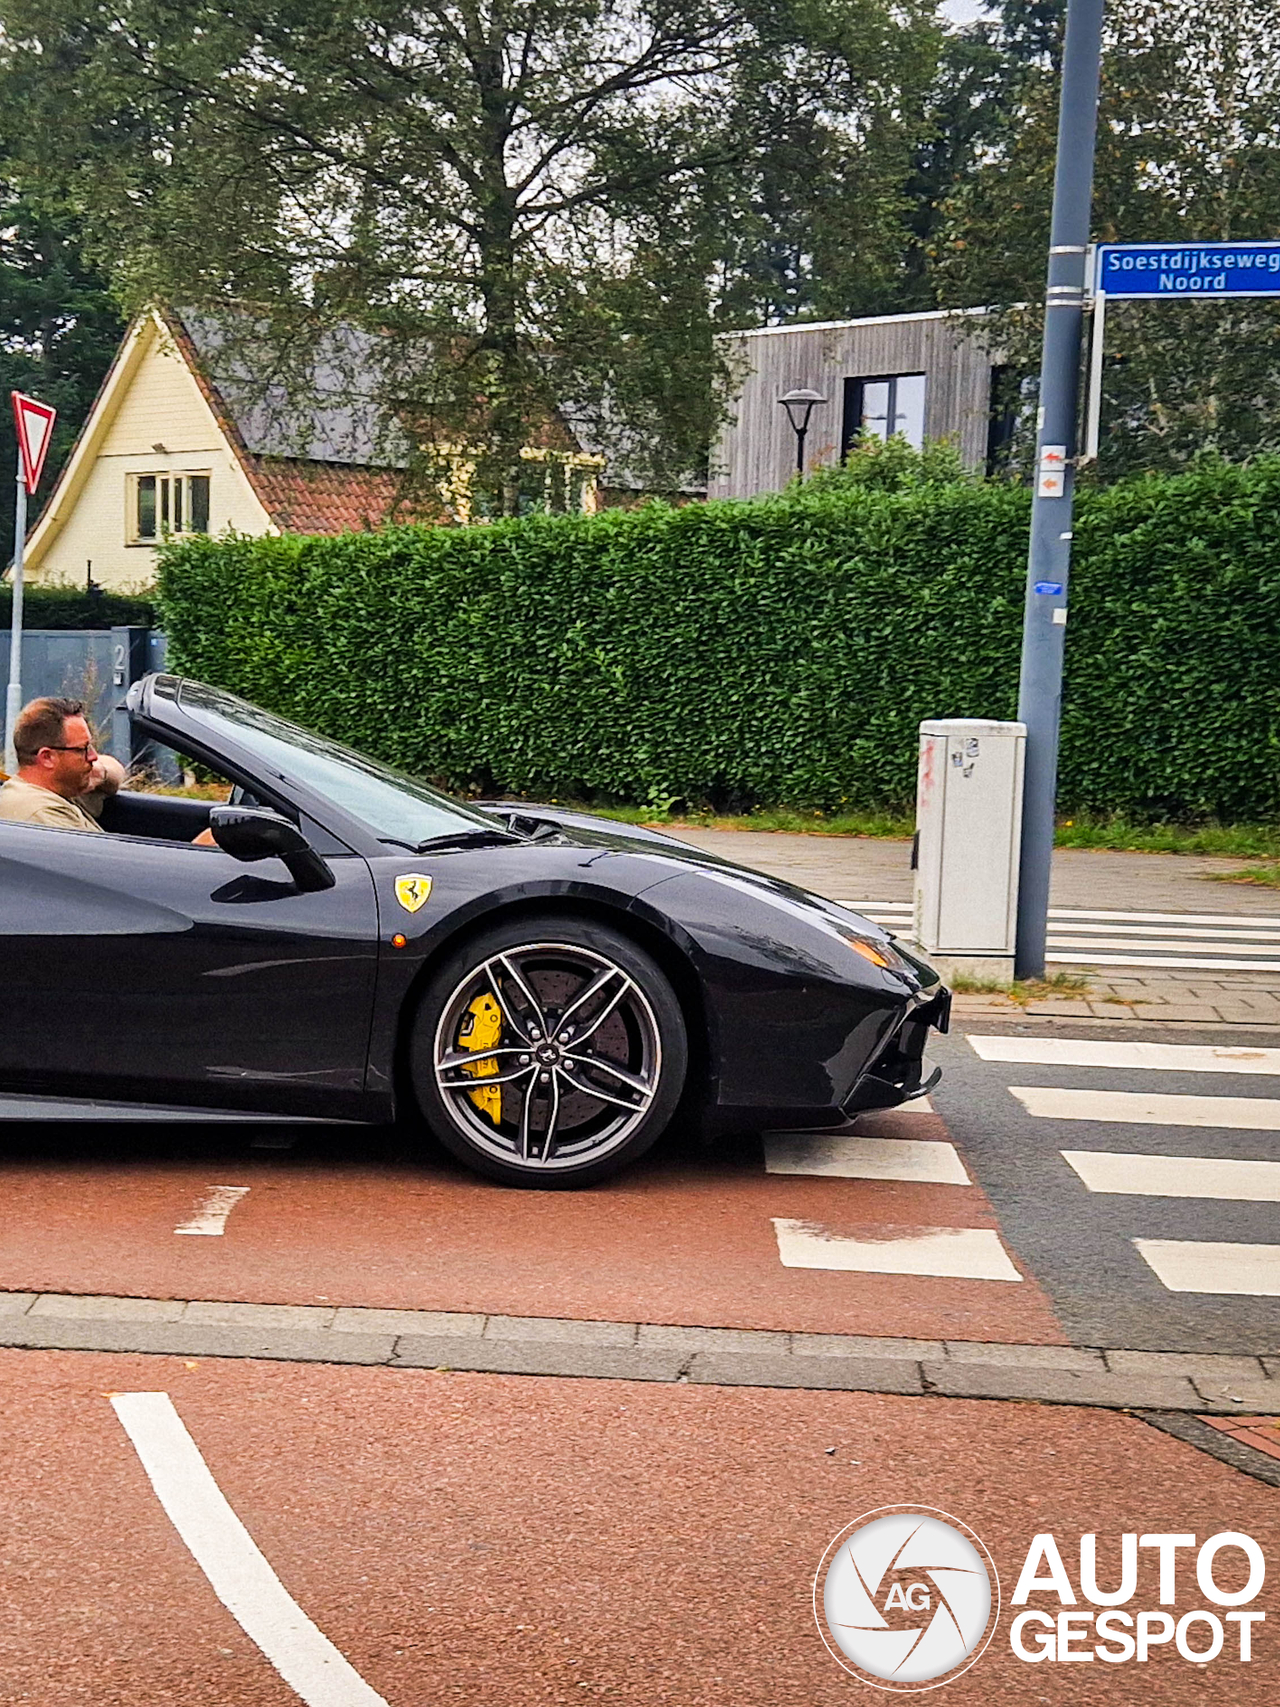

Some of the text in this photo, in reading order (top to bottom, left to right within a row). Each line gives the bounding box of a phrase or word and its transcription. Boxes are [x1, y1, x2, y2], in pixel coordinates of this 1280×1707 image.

[1108, 251, 1280, 273] Soestdijkseweg
[1158, 272, 1226, 290] Noord
[114, 644, 125, 669] 2
